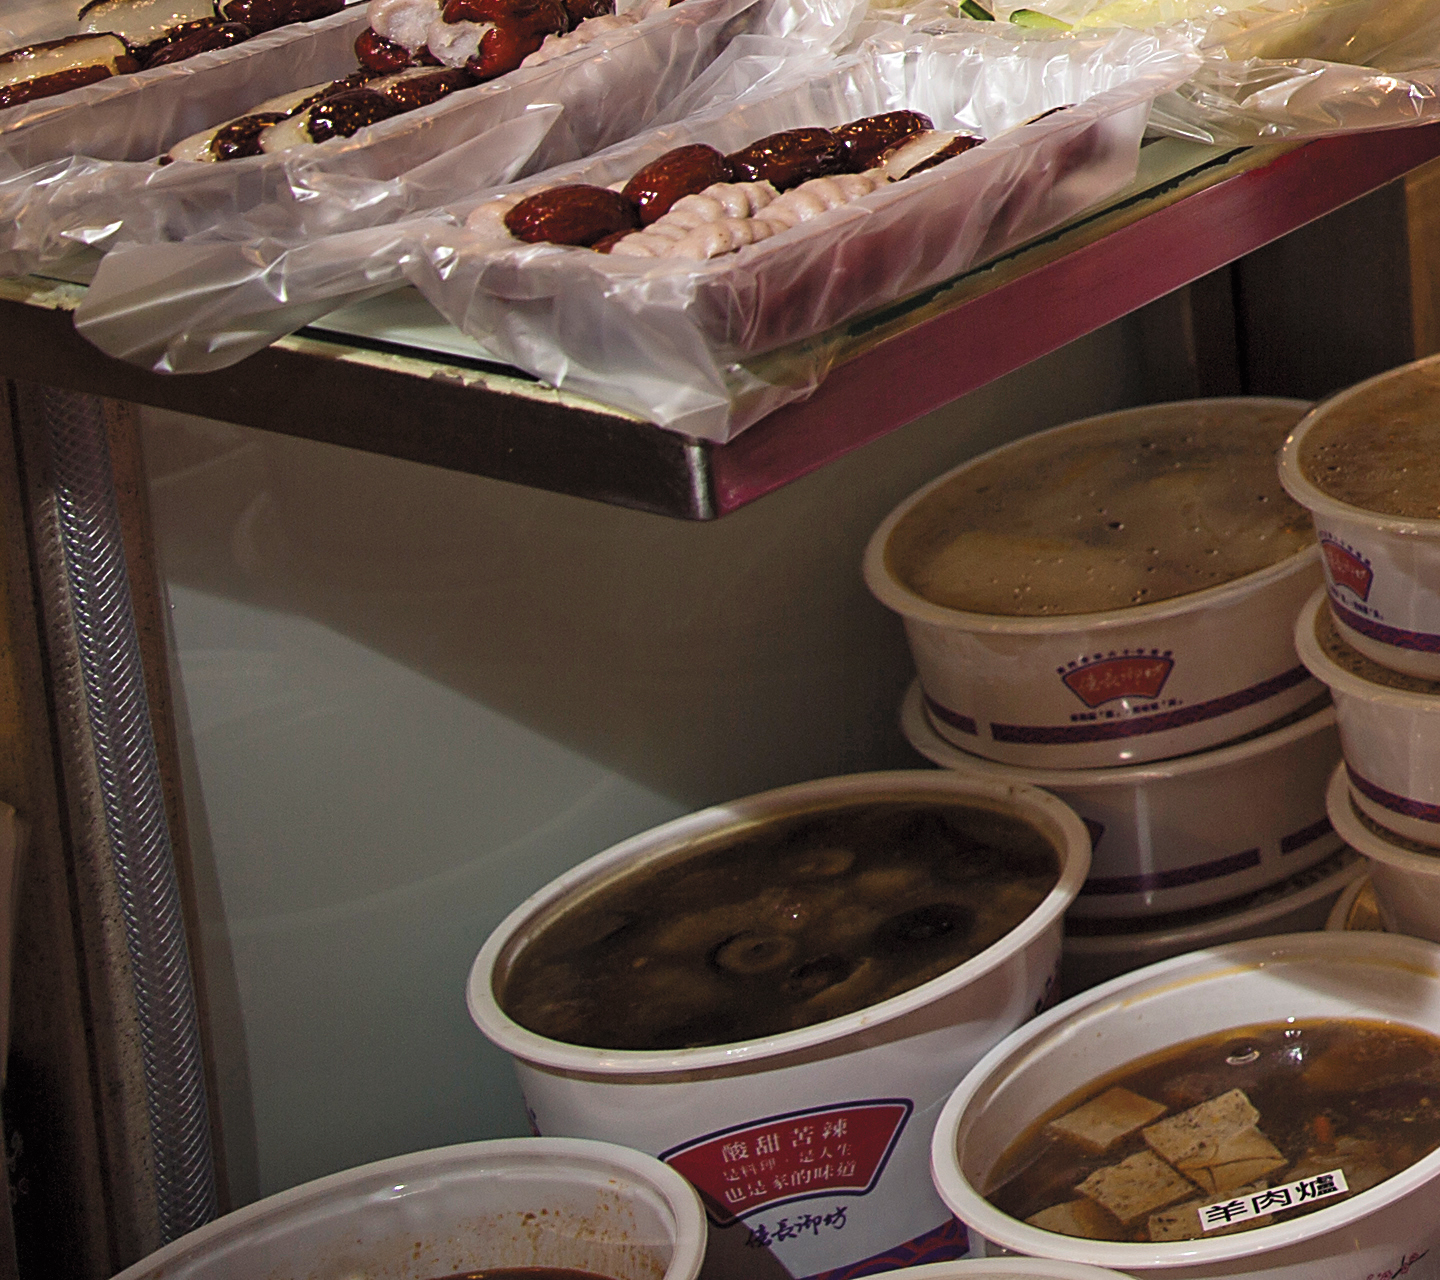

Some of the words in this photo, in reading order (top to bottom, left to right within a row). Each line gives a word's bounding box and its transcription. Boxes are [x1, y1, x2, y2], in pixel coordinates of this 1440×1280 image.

[722, 1118, 848, 1162] 酸甜苦辣
[724, 1160, 856, 1203] 也是家的味道
[1206, 1174, 1338, 1222] 羊肉爐
[746, 1206, 848, 1247] 億長御坊
